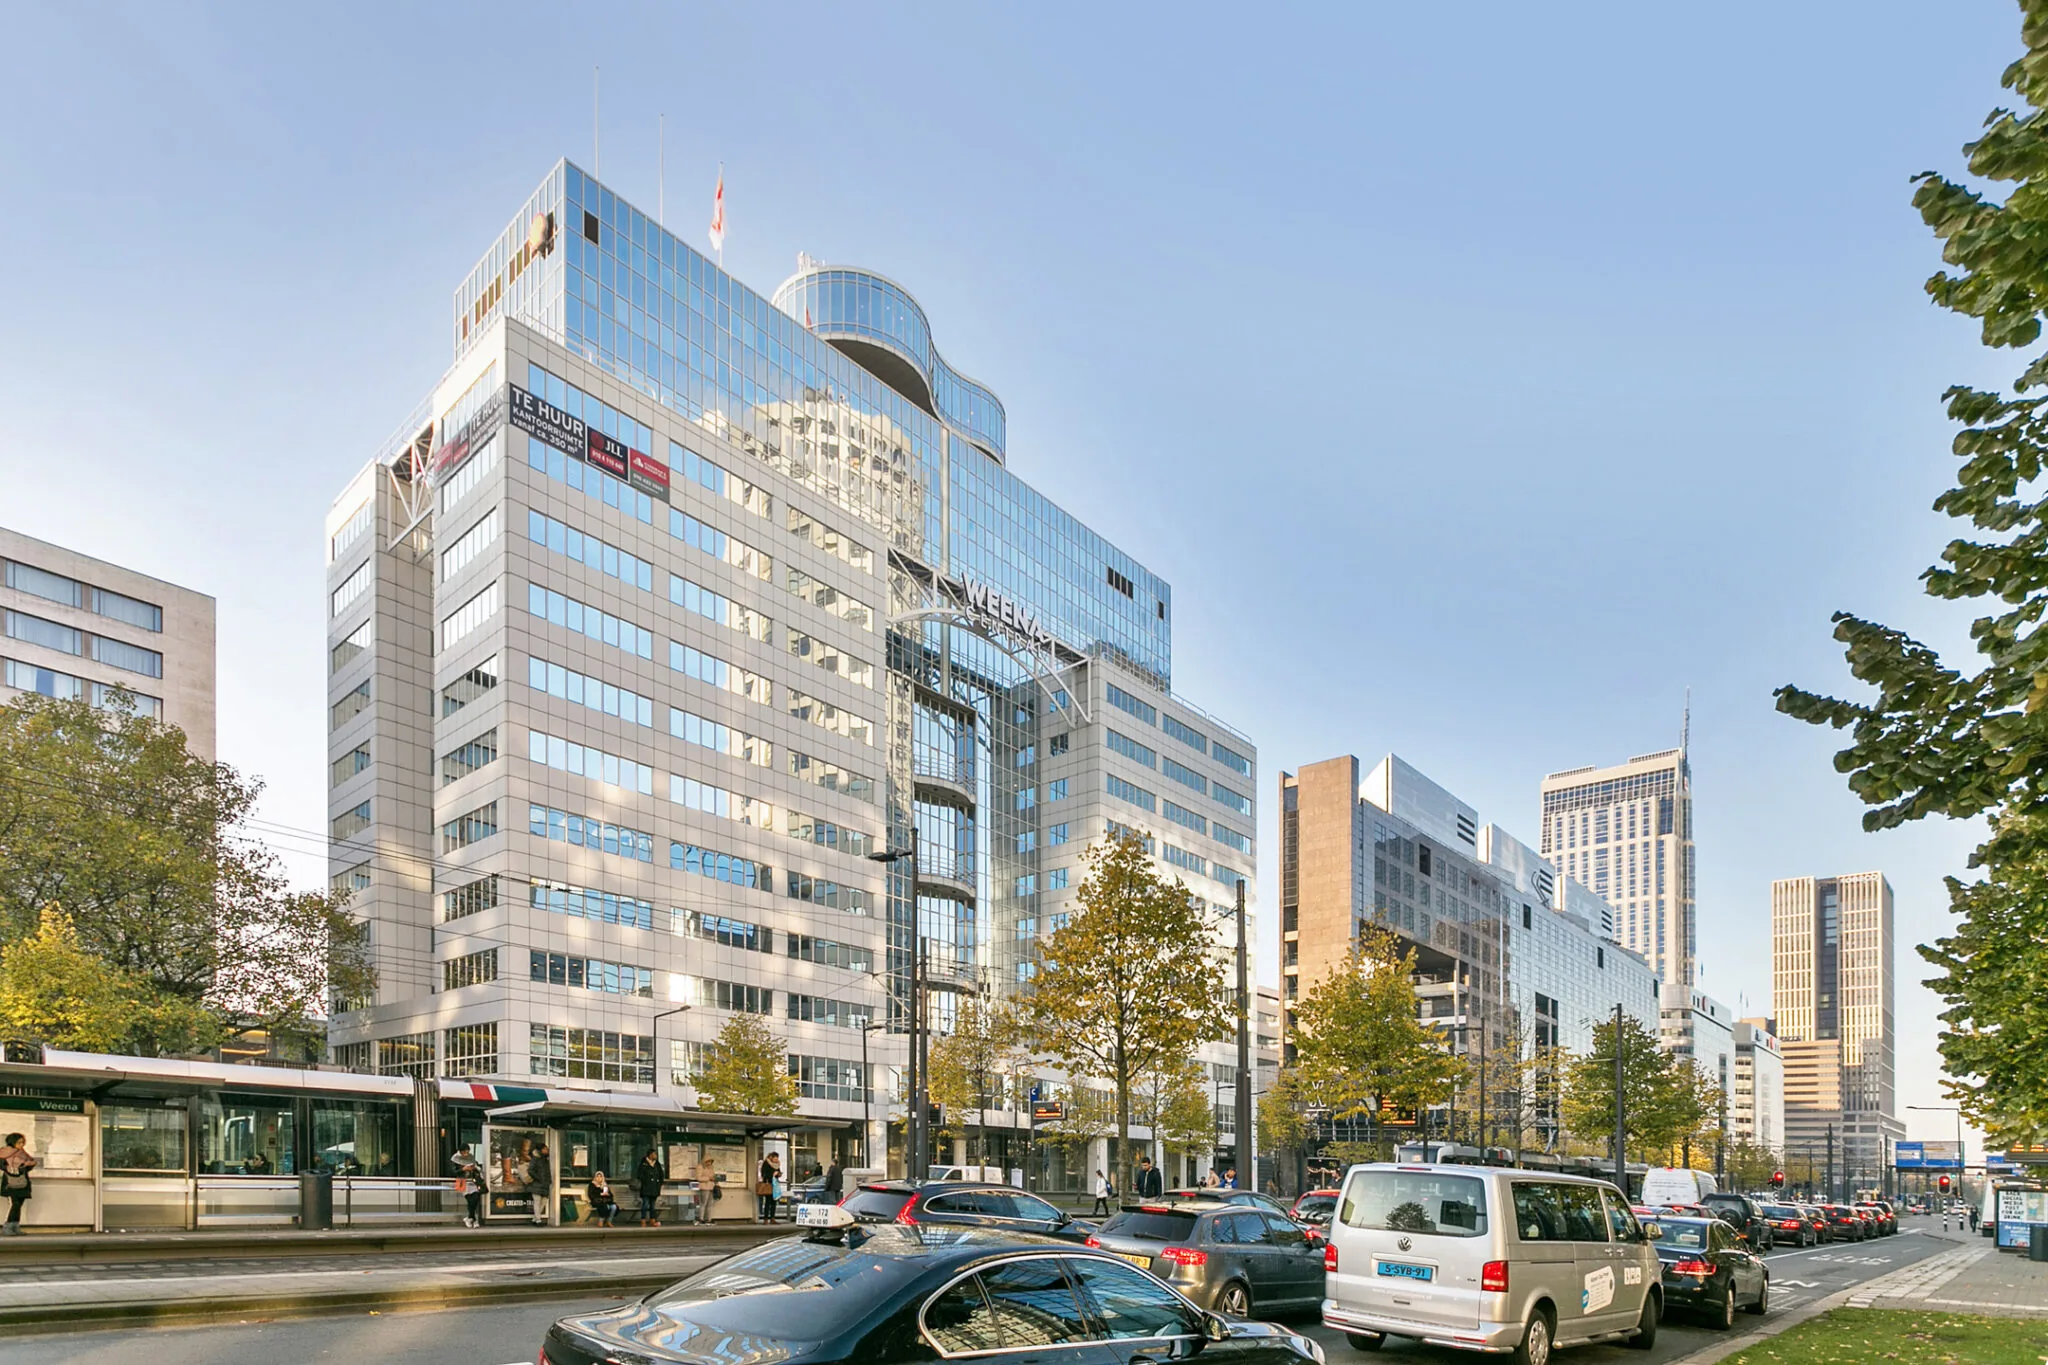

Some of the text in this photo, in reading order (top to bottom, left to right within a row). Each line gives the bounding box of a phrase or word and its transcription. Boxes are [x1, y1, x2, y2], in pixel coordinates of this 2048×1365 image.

[512, 387, 533, 411] TE
[538, 401, 584, 438] HUUR
[512, 406, 584, 449] KANTOORRUIMTE
[512, 417, 535, 433] vanaf
[536, 429, 548, 440] ca.
[549, 434, 566, 449] 350
[604, 440, 624, 458] JLL
[962, 572, 1046, 644] WEENA
[40, 1101, 78, 1111] Weena
[818, 1208, 829, 1217] 172
[1385, 1264, 1425, 1277] 5-SVB-91
